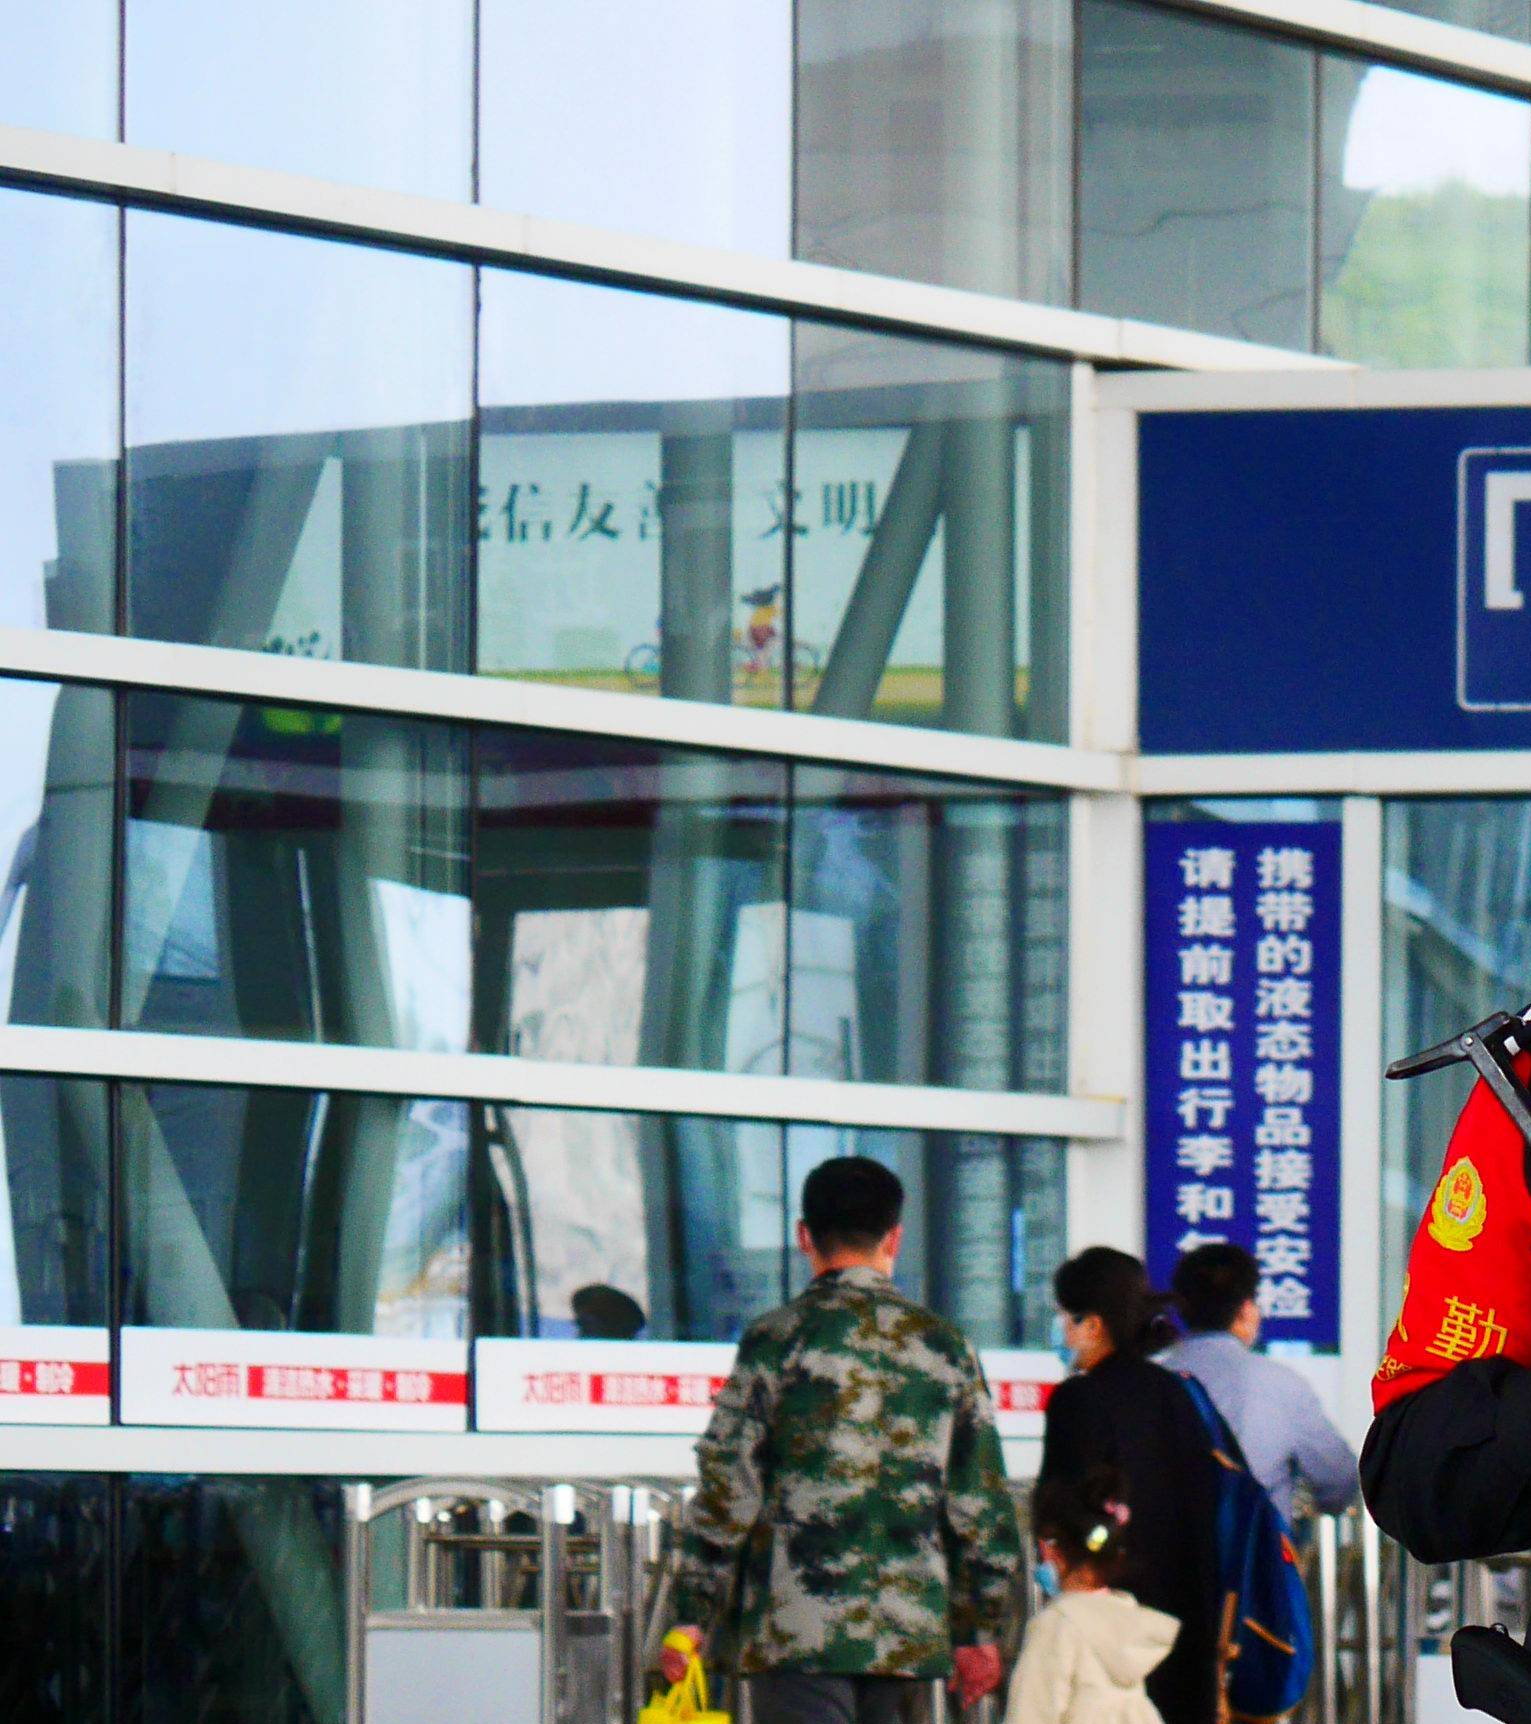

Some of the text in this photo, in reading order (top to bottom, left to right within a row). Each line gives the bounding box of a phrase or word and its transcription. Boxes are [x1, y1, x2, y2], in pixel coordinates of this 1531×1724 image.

[1177, 847, 1236, 1253] 请提前取出行李和
